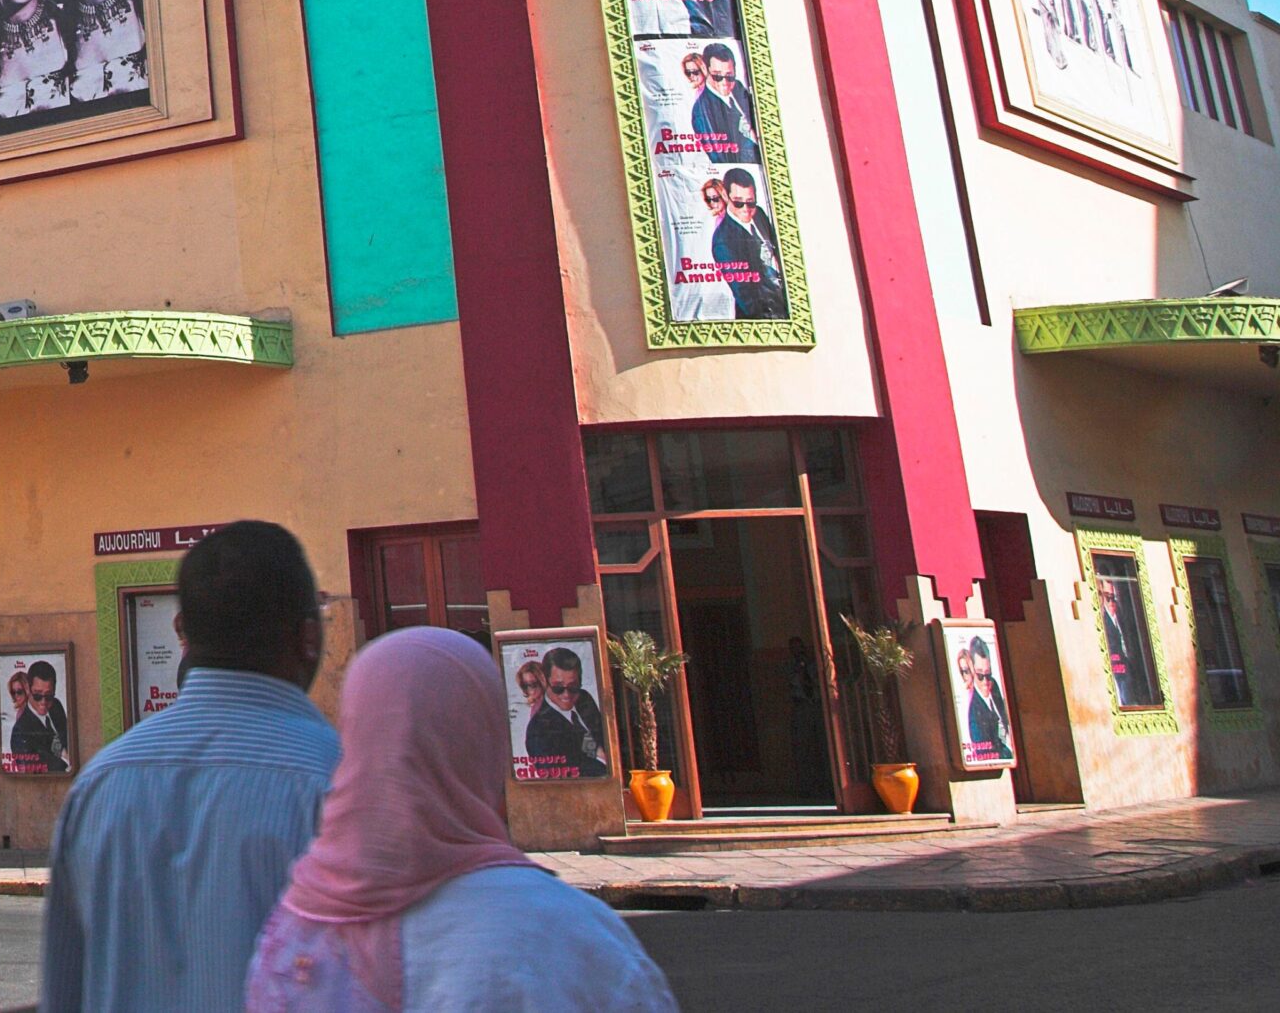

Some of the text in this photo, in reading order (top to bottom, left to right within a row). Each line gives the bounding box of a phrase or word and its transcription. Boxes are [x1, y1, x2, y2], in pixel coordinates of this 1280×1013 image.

[660, 127, 728, 143] Braqueurs
[654, 141, 740, 155] Amateurs
[679, 257, 750, 272] Braqueurs
[674, 270, 761, 285] Amateurs
[99, 530, 160, 552] AUJOURD'HUI
